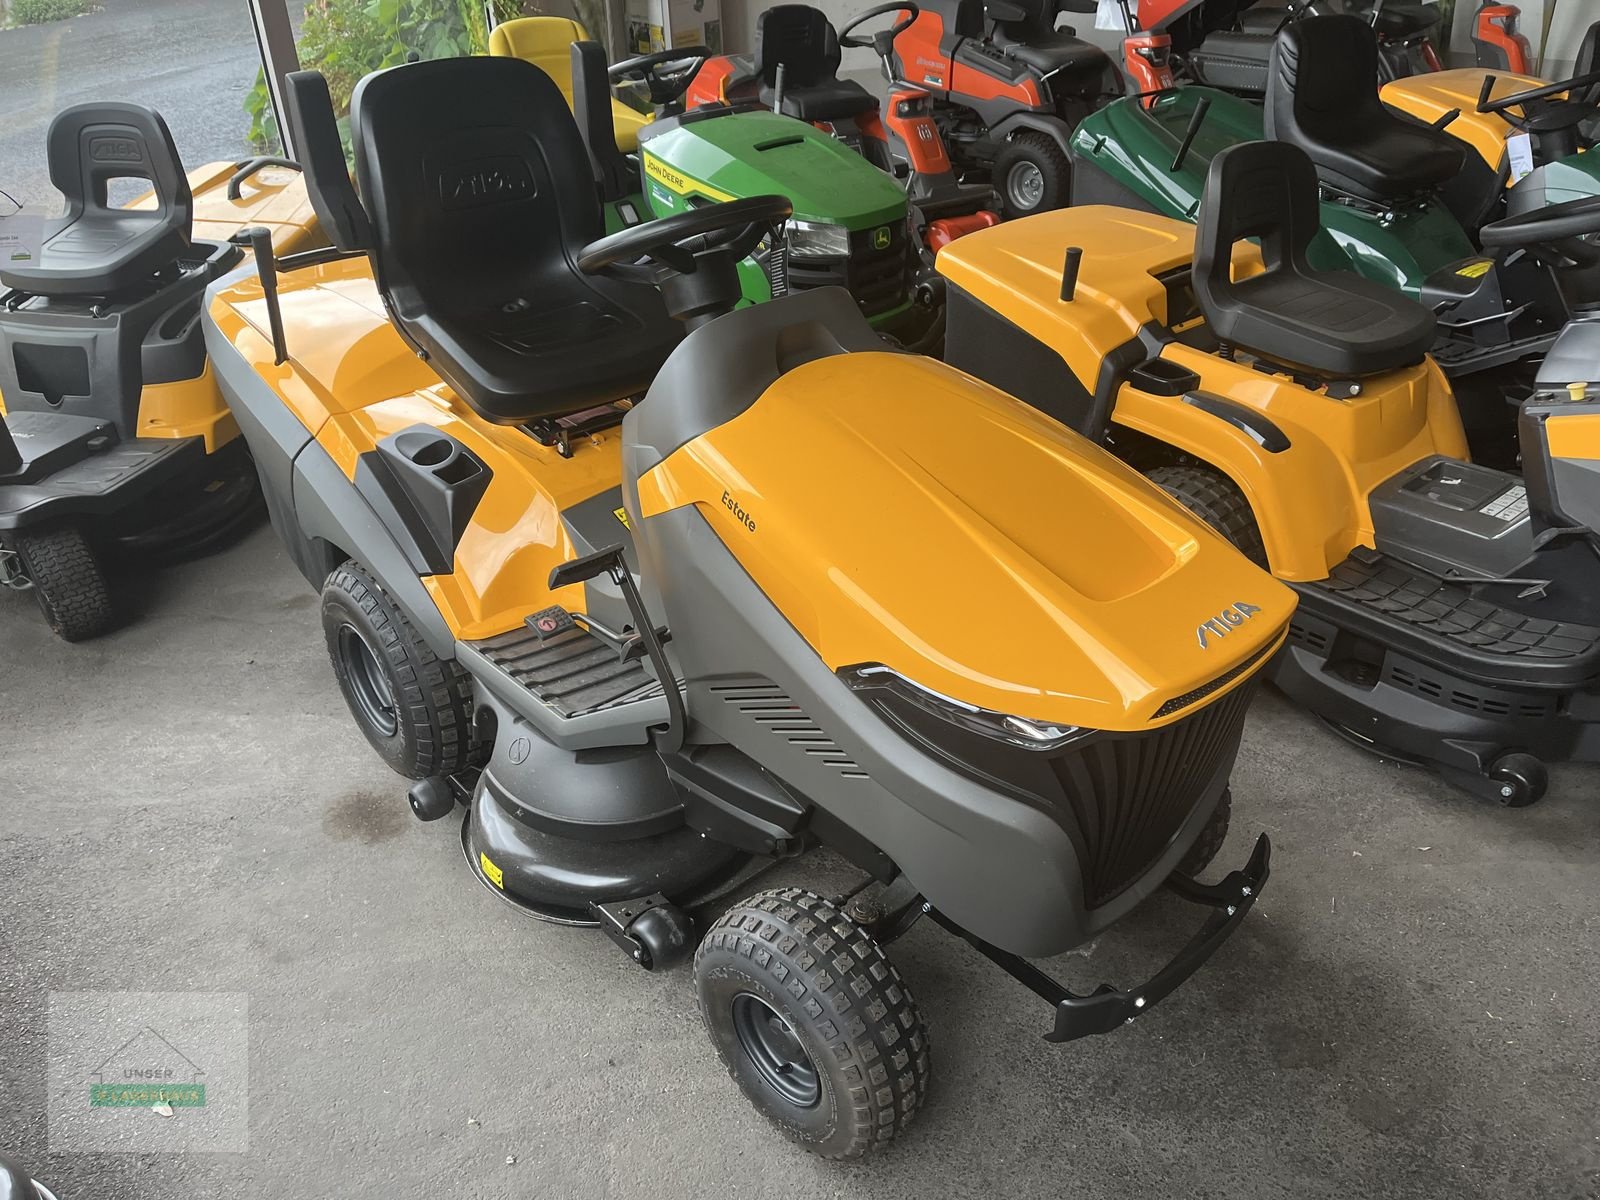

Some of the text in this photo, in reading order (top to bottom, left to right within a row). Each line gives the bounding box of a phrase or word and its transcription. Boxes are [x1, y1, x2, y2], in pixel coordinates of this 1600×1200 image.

[647, 159, 684, 188] JOHN DEERE
[721, 490, 756, 532] Estate
[1197, 602, 1261, 649] STIGA
